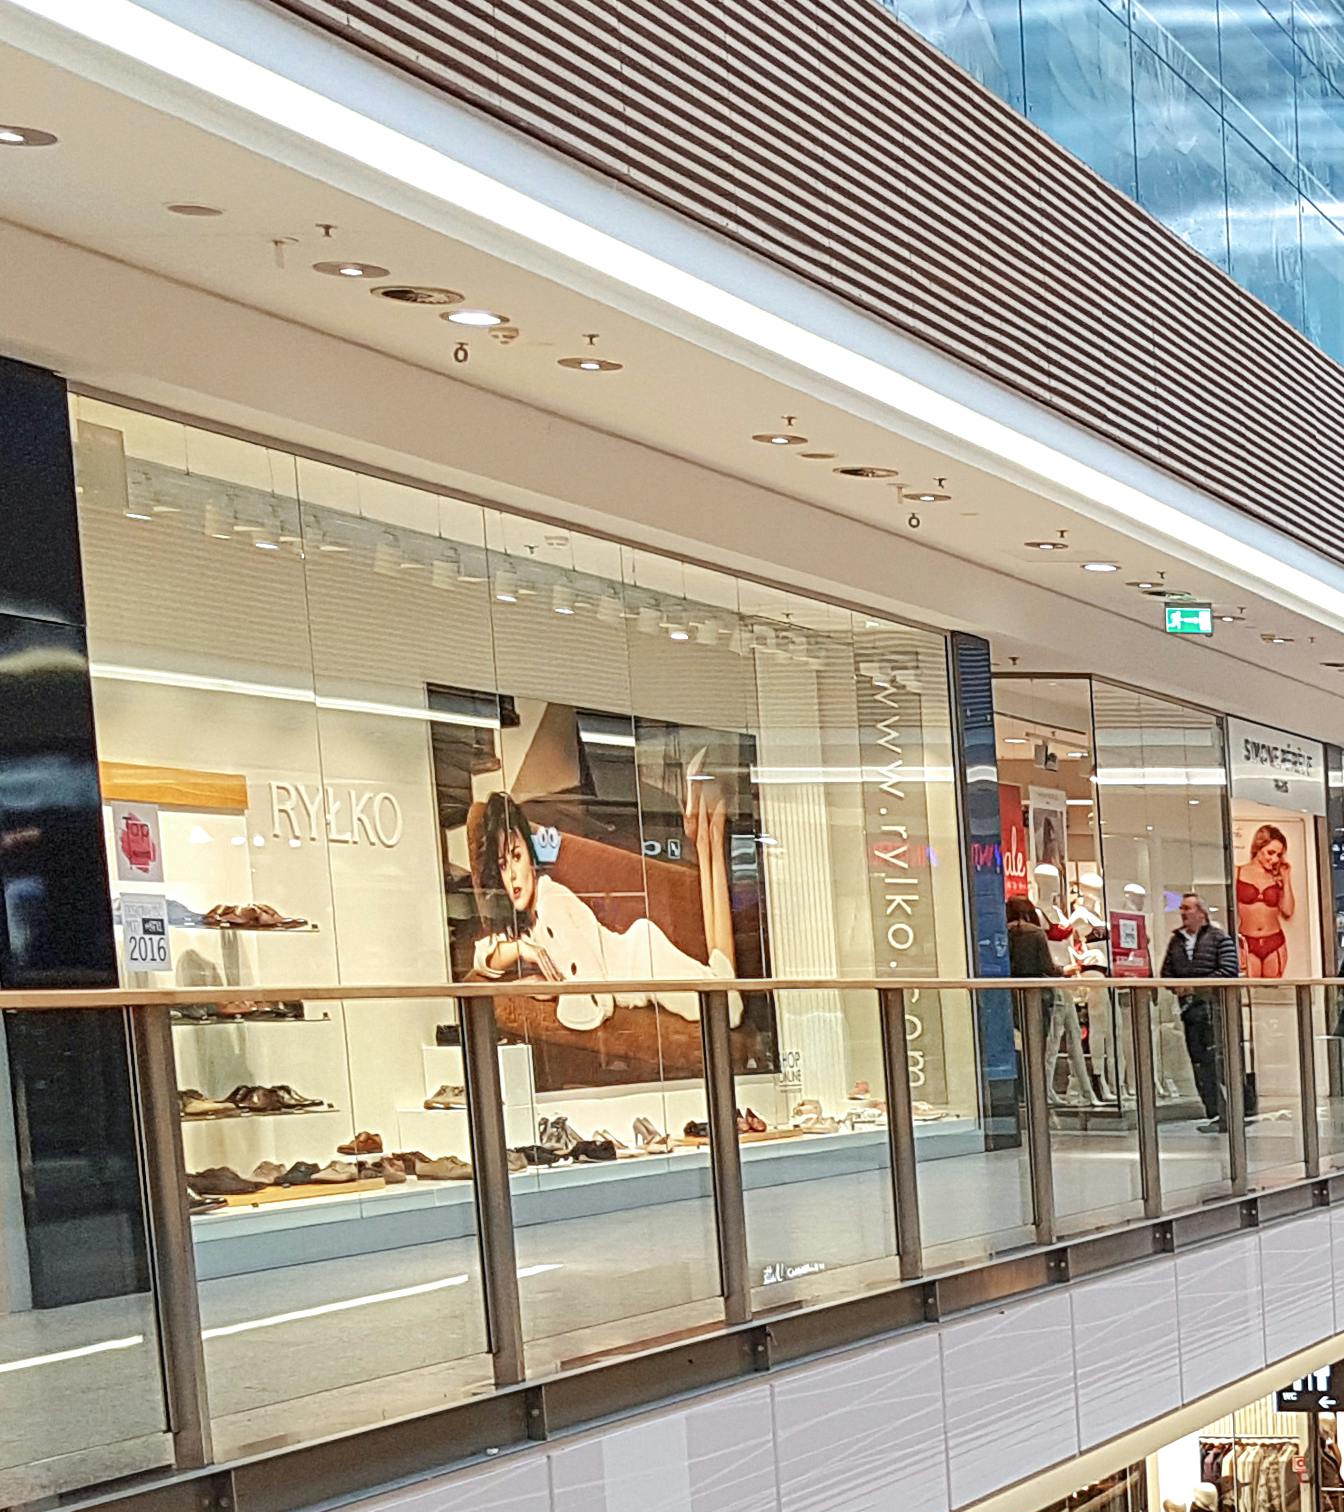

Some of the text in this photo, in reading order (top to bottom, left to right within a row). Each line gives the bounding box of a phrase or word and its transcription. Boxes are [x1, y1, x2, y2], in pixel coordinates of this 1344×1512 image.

[269, 781, 402, 848] RYŁKO
[1003, 825, 1025, 876] ale
[129, 936, 167, 961] 2016
[1282, 1391, 1298, 1401] WC
